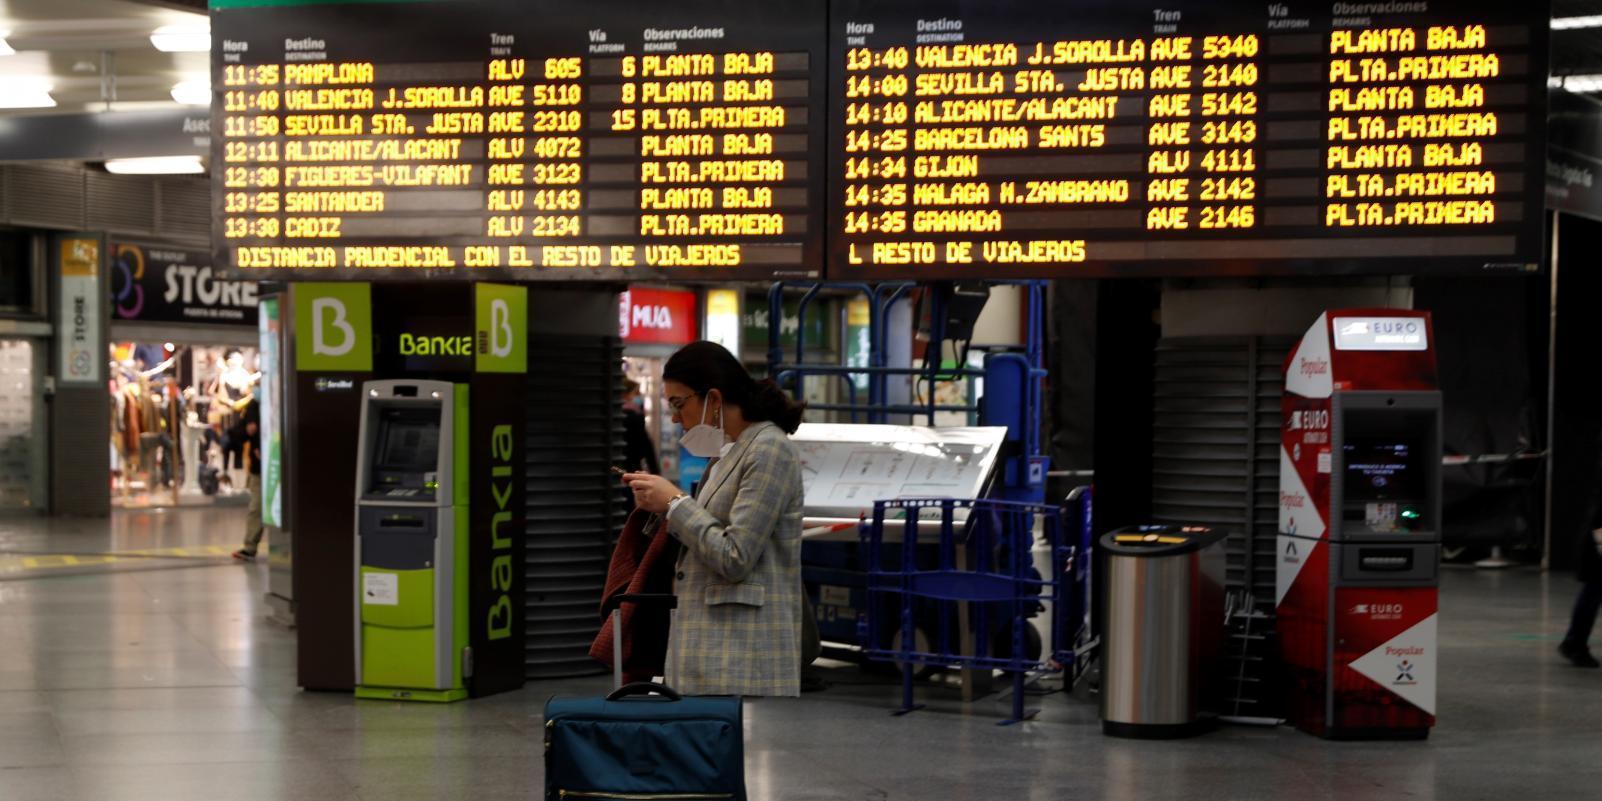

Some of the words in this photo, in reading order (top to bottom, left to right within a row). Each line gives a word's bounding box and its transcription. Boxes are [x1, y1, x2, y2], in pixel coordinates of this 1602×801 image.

[1153, 9, 1181, 21] Tren
[1332, 1, 1427, 15] Observaciones
[589, 29, 607, 42] Vía
[644, 26, 724, 41] Observaciones
[846, 22, 874, 34] Hora
[917, 17, 962, 31] Destino
[223, 40, 248, 52] Hora
[285, 37, 325, 50] Destino
[491, 33, 514, 45] Tren
[847, 47, 908, 70] 13:40
[916, 44, 1017, 67] VALENCIA
[1028, 39, 1144, 66] J.SOROLLA
[1151, 37, 1191, 60] AVE
[1203, 35, 1258, 58] 5340
[1331, 28, 1415, 53] PLANTA
[1427, 25, 1485, 49] BAJA
[224, 65, 279, 86] 11:35
[285, 63, 373, 85] PAMPLONA
[489, 59, 524, 80] ALV
[545, 58, 580, 78] 605
[622, 56, 635, 77] 6
[642, 54, 714, 76] PLANTA
[724, 53, 773, 74] BAJA
[847, 75, 907, 97] 14:00
[916, 72, 1003, 95] SEVILLA
[1015, 70, 1064, 92] STA.
[1078, 67, 1144, 91] JUSTA
[1150, 66, 1191, 88] AVE
[1203, 64, 1257, 87] 2140
[1330, 54, 1498, 82] PLTA.PRIMERA
[225, 90, 279, 111] 11:40
[285, 89, 373, 110] VALENCIA
[382, 87, 483, 108] J.SOROLLA
[489, 86, 524, 106] AVE
[534, 84, 581, 105] 5110
[622, 83, 635, 103] 8
[642, 81, 714, 103] PLANTA
[724, 79, 773, 101] BAJA
[846, 102, 907, 124] 14:10
[915, 97, 1117, 122] ALICANTE/ALACANT
[1150, 94, 1190, 117] AVE
[1202, 92, 1256, 115] 5142
[1329, 87, 1413, 111] PLANTA
[1425, 84, 1483, 110] BAJA
[225, 116, 279, 137] 11:50
[285, 115, 363, 136] SEVILLA
[371, 114, 414, 134] STA.
[426, 113, 483, 133] JUSTA
[488, 112, 524, 132] AVE
[533, 111, 581, 131] 2310
[612, 110, 635, 130] 15
[642, 106, 784, 129] PLTA.PRIMERA
[846, 129, 907, 151] 14:25
[915, 127, 1028, 150] BARCELONA
[1039, 125, 1104, 147] SANTS
[1149, 122, 1190, 145] AVE
[1202, 121, 1255, 143] 3143
[1328, 112, 1496, 140] PLTA.PRIMERA
[225, 141, 279, 162] 12:11
[285, 139, 461, 161] ALICANTE/ALACANT
[488, 138, 524, 158] ALV
[534, 137, 580, 158] 4072
[642, 135, 713, 156] PLANTA
[723, 133, 772, 154] BAJA
[846, 157, 906, 178] 14:34
[914, 156, 977, 177] GIJON
[1149, 151, 1189, 173] ALV
[1201, 149, 1255, 171] 4111
[1328, 145, 1411, 171] PLANTA
[1424, 143, 1481, 166] BAJA
[225, 167, 279, 187] 12:30
[285, 165, 472, 187] FIGUERES-VILAFANT
[488, 164, 524, 184] AVE
[533, 163, 580, 184] 3123
[642, 160, 784, 182] PLTA.PRIMERA
[225, 192, 279, 212] 13:25
[285, 191, 386, 212] SANTANDER
[488, 190, 524, 211] ALV
[534, 190, 580, 210] 4143
[641, 188, 713, 209] PLANTA
[723, 187, 771, 208] BAJA
[846, 184, 906, 206] 14:35
[914, 183, 989, 204] MALAGA
[1000, 180, 1128, 203] M.ZAMBRANO
[1148, 179, 1189, 201] AVE
[1200, 178, 1254, 200] 2142
[1327, 172, 1494, 199] PLTA.PRIMERA
[225, 218, 279, 237] 13:30
[285, 217, 341, 237] CADIZ
[488, 216, 526, 237] ALV
[531, 216, 580, 236] 2134
[641, 214, 783, 235] PLTA.PRIMERA
[845, 211, 908, 233] 14:35
[913, 210, 1001, 232] GRANADA
[1147, 207, 1188, 229] AVE
[1200, 206, 1254, 228] 2146
[1327, 201, 1494, 229] PLTA.PRIMERA
[238, 247, 336, 267] DISTANCIA
[344, 247, 455, 267] PRUDENCIAL
[464, 246, 499, 266] CON
[508, 246, 534, 266] EL
[540, 246, 600, 266] RESTO
[609, 246, 635, 266] DE
[645, 245, 740, 265] VIAJEROS
[873, 242, 935, 263] RESTO
[946, 242, 972, 263] DE
[983, 241, 1085, 262] VIAJEROS
[164, 264, 258, 306] STORE
[74, 297, 85, 341] STORE
[1374, 322, 1417, 333] EURO
[399, 333, 472, 355] Bankia
[1304, 410, 1328, 429] EURO
[488, 424, 512, 640] Bankia
[1371, 603, 1402, 613] EURO
[1385, 646, 1424, 658] Popular
